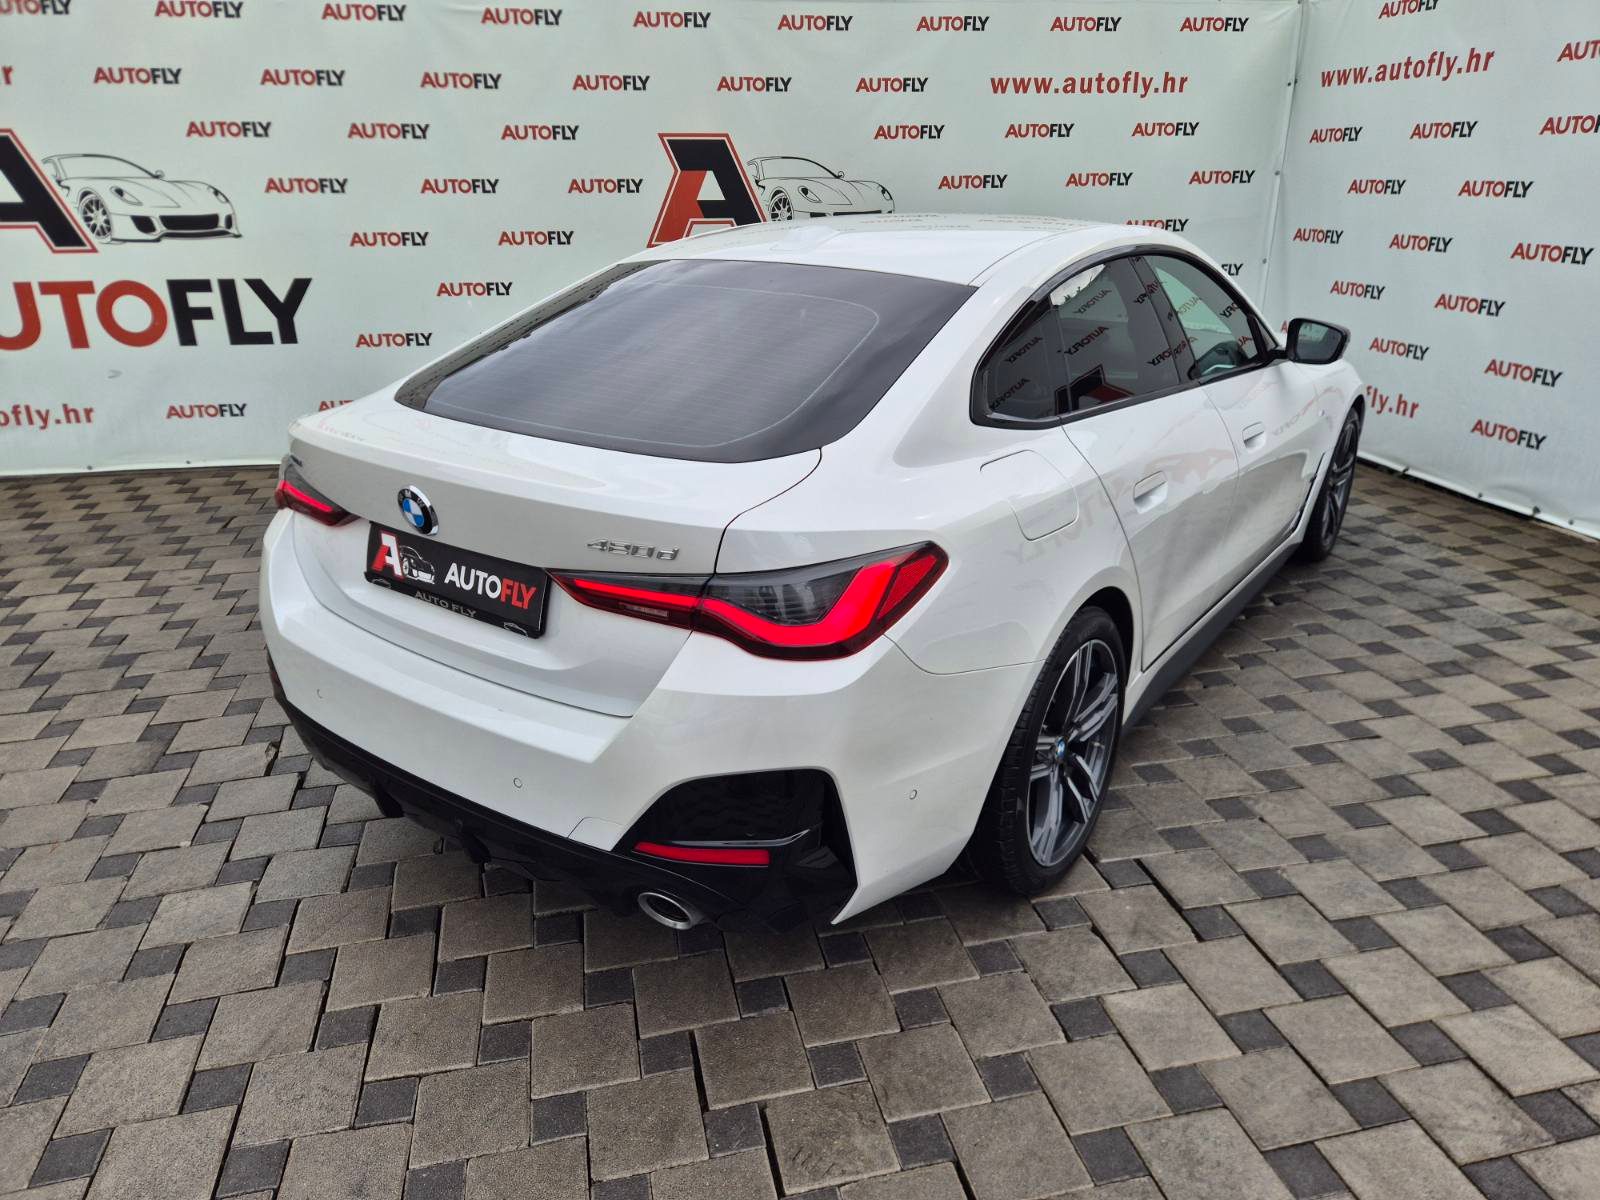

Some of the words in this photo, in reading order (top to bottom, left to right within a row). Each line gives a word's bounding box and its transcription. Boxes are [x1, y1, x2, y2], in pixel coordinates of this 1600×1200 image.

[0, 0, 71, 15] UTOFLY
[155, 0, 243, 18] AUTOFLY
[322, 3, 406, 21] AUTOFLY
[481, 8, 562, 26] AUTOFLY
[633, 11, 711, 28] AUTOFLY
[778, 15, 853, 31] AUTOFLY
[916, 16, 989, 31] AUTOFLY
[1050, 17, 1122, 32] AUTOFLY
[1180, 17, 1249, 32] AUTOFLY
[1557, 40, 1600, 62] AUT
[94, 67, 182, 84] AUTOFLY
[1322, 48, 1495, 87] www.autofly.hr
[260, 69, 345, 86] AUTOFLY
[420, 72, 502, 89] AUTOFLY
[572, 75, 650, 91] AUTOFLY
[717, 76, 792, 92] AUTOFLY
[856, 77, 928, 93] AUTOFLY
[991, 71, 1188, 98] www.autofly.hr
[186, 121, 271, 138] AUTOFLY
[348, 123, 429, 139] AUTOFLY
[501, 125, 579, 140] AUTOFLY
[874, 125, 945, 140] AUTOFLY
[1005, 123, 1075, 138] AUTOFLY
[1132, 122, 1199, 136] AUTOFLY
[1309, 127, 1363, 143] AUTOFLY
[1410, 121, 1478, 139] AUTOFLY
[938, 174, 1008, 189] AUTOFLY
[1066, 172, 1133, 187] AUTOFLY
[1189, 170, 1255, 184] AUTOFLY
[265, 178, 348, 193] AUTOFLY
[421, 179, 499, 194] AUTOFLY
[568, 179, 643, 193] AUTOFLY
[1347, 179, 1406, 195] AUTOFLY
[1458, 180, 1534, 198] AUTOFLY
[350, 232, 429, 247] AUTOFLY
[498, 231, 574, 246] AUTOFLY
[1293, 228, 1344, 244] AUTOFLY
[1389, 234, 1453, 253] AUTOFLY
[1510, 243, 1594, 265] AUTOFLY
[437, 282, 512, 296] AUTOFLY
[1330, 281, 1385, 300] AUTOFLY
[1434, 294, 1506, 317] AUTOFLY
[0, 277, 313, 351] UTOFLY
[356, 333, 432, 348] AUTOFLY
[1369, 338, 1429, 361] AUTOFLY
[1484, 359, 1563, 387] AUTOFLY
[167, 403, 247, 419] AUTOFLY
[1471, 419, 1547, 450] AUTOFLY
[586, 538, 680, 561] 420d
[444, 562, 537, 610] AUTOFLY
[415, 590, 449, 608] AUTO
[450, 604, 477, 618] FLY
